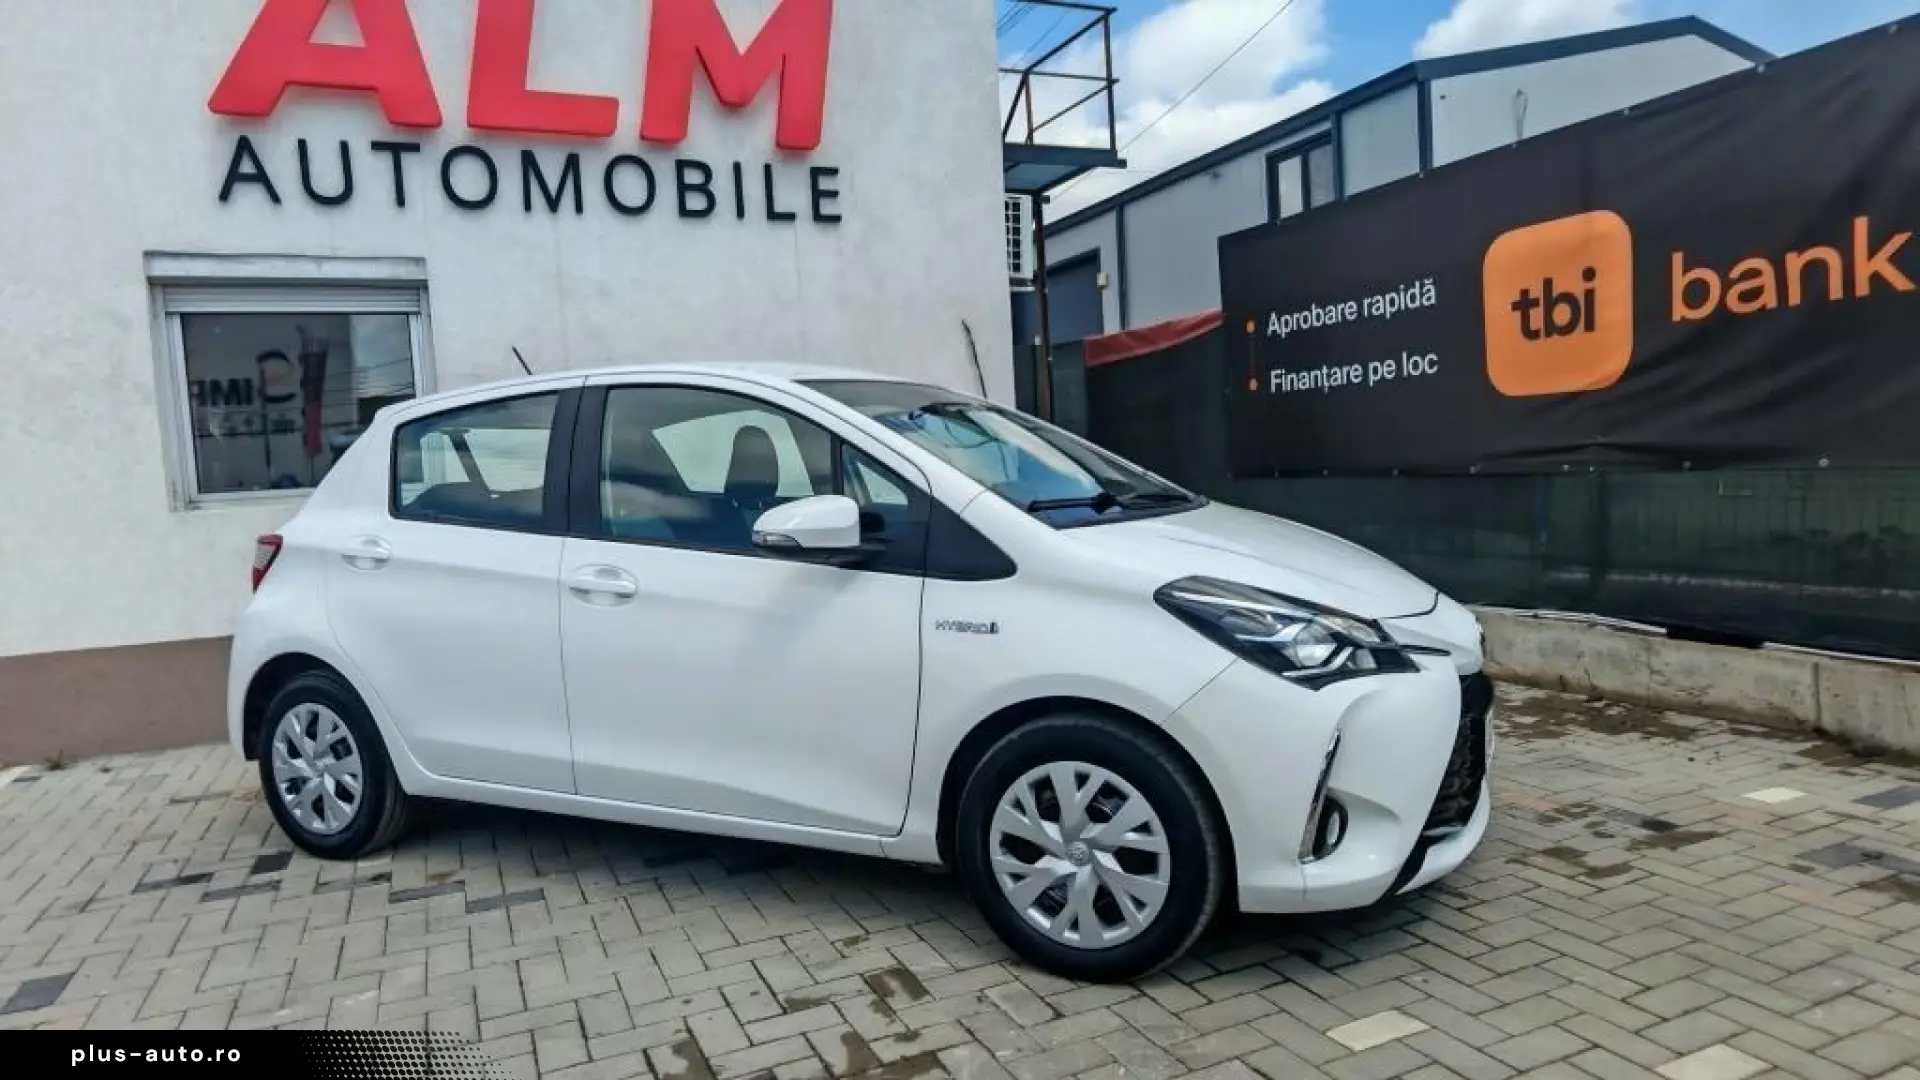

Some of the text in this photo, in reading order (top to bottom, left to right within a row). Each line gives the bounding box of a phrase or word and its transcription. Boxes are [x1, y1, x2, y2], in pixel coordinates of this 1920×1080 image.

[207, 0, 834, 151] ALM
[218, 134, 843, 224] AUTOMOBILE
[1266, 277, 1437, 338] Aprobare rapidă
[1510, 215, 1918, 342] tbi bank
[1367, 358, 1397, 387] pe
[1401, 350, 1439, 377] loc
